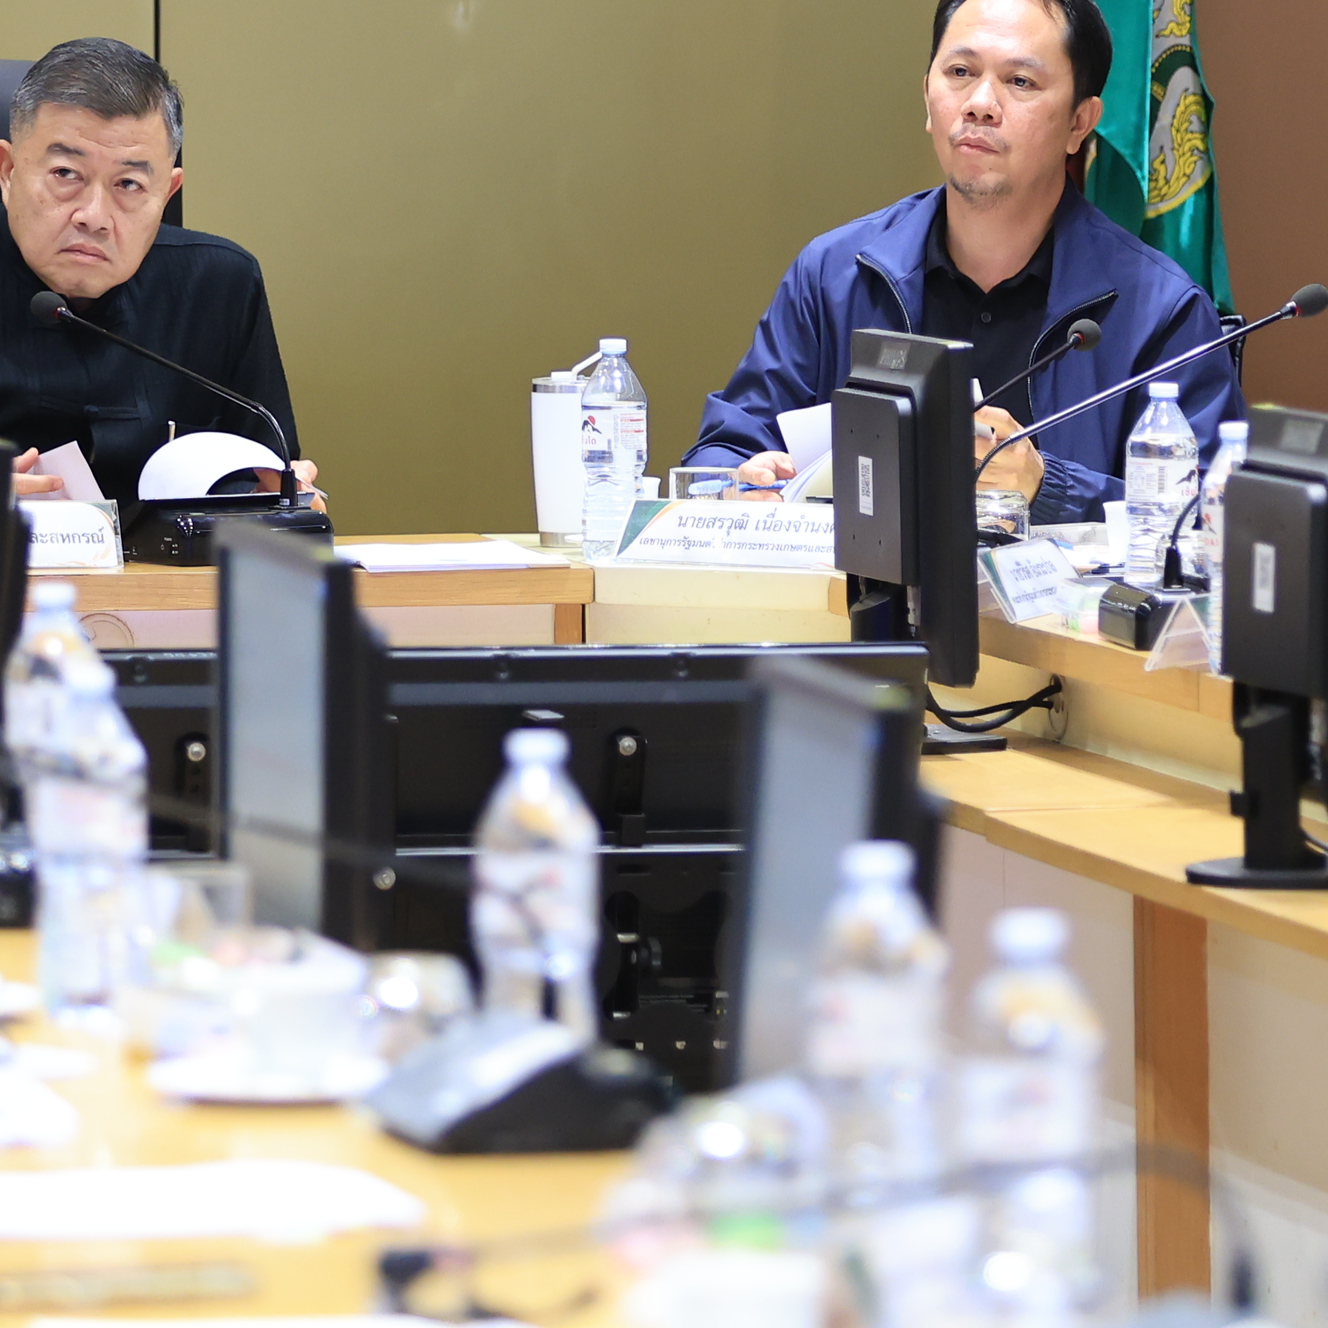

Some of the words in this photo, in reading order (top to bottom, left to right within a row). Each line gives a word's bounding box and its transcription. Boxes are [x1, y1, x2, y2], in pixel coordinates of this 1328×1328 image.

[29, 526, 105, 544] ละสหกรณ์
[677, 512, 750, 537] นายสรวุฒิ
